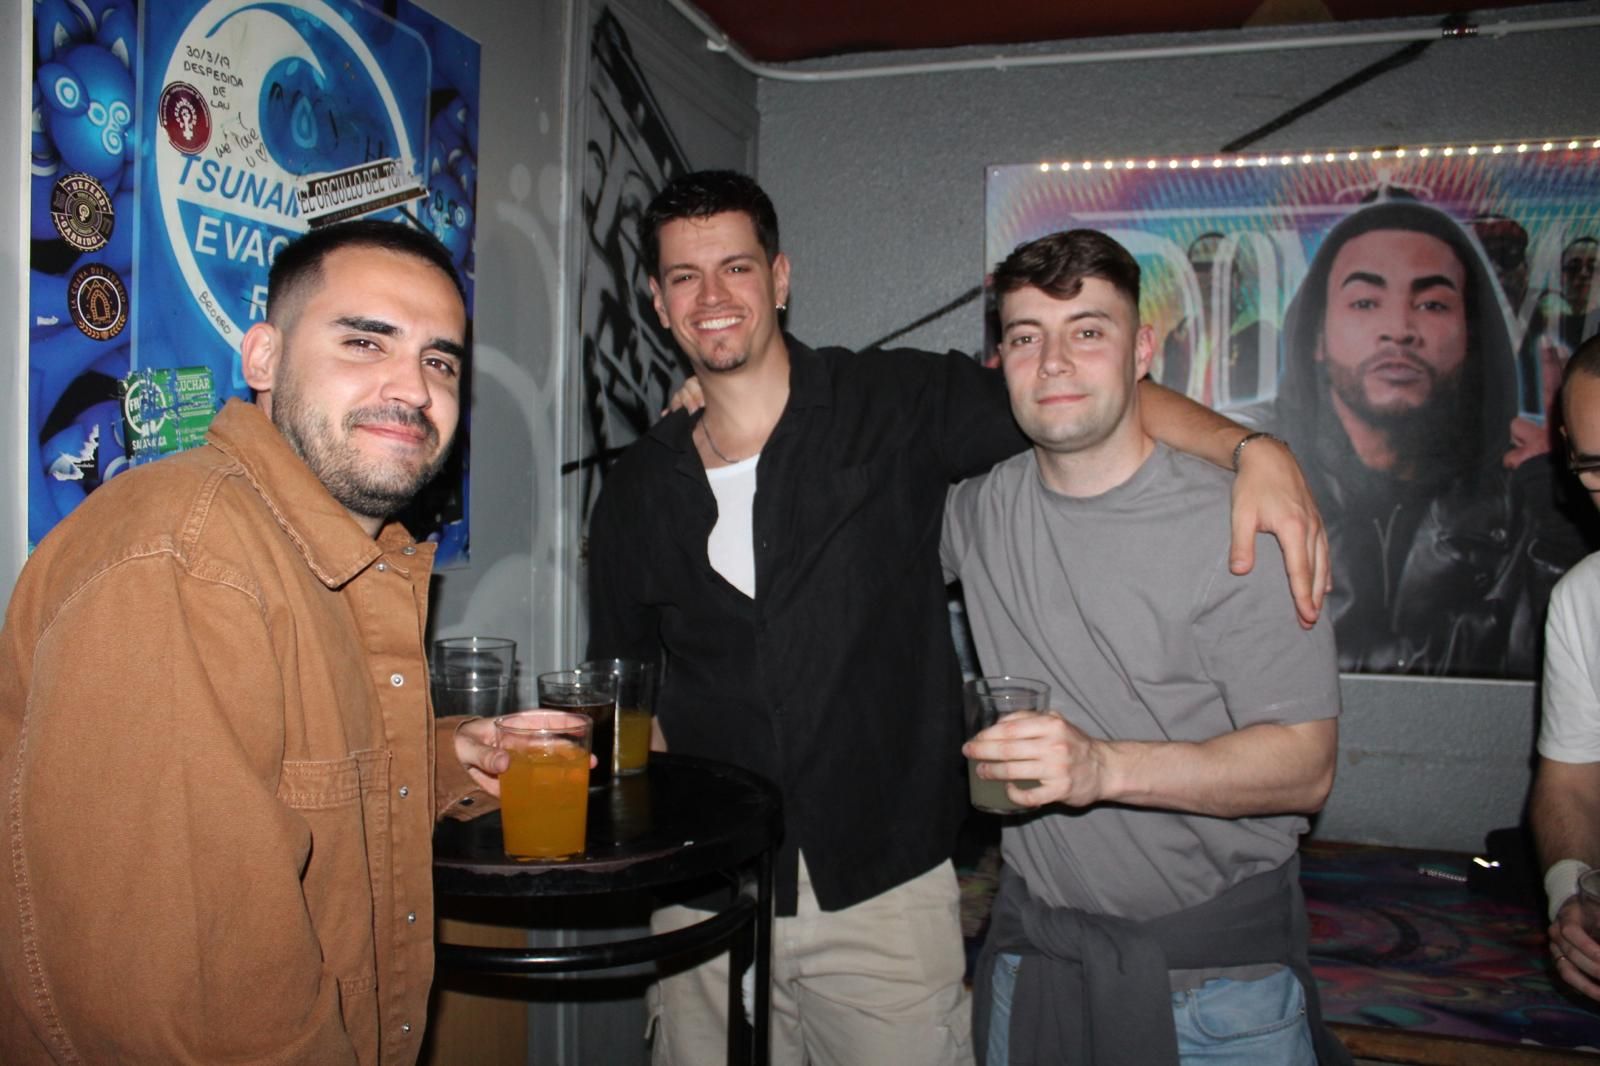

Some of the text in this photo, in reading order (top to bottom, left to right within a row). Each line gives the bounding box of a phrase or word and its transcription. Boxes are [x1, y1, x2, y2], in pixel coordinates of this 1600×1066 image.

[186, 45, 230, 69] 30/3/19
[184, 60, 244, 88] DESPEDIDA
[212, 86, 226, 98] DE
[71, 181, 105, 206] DEFEND
[179, 154, 299, 218] TSUNAM
[314, 171, 363, 209] ORGULLO
[362, 166, 385, 195] DEL
[61, 220, 97, 246] GARRIDO
